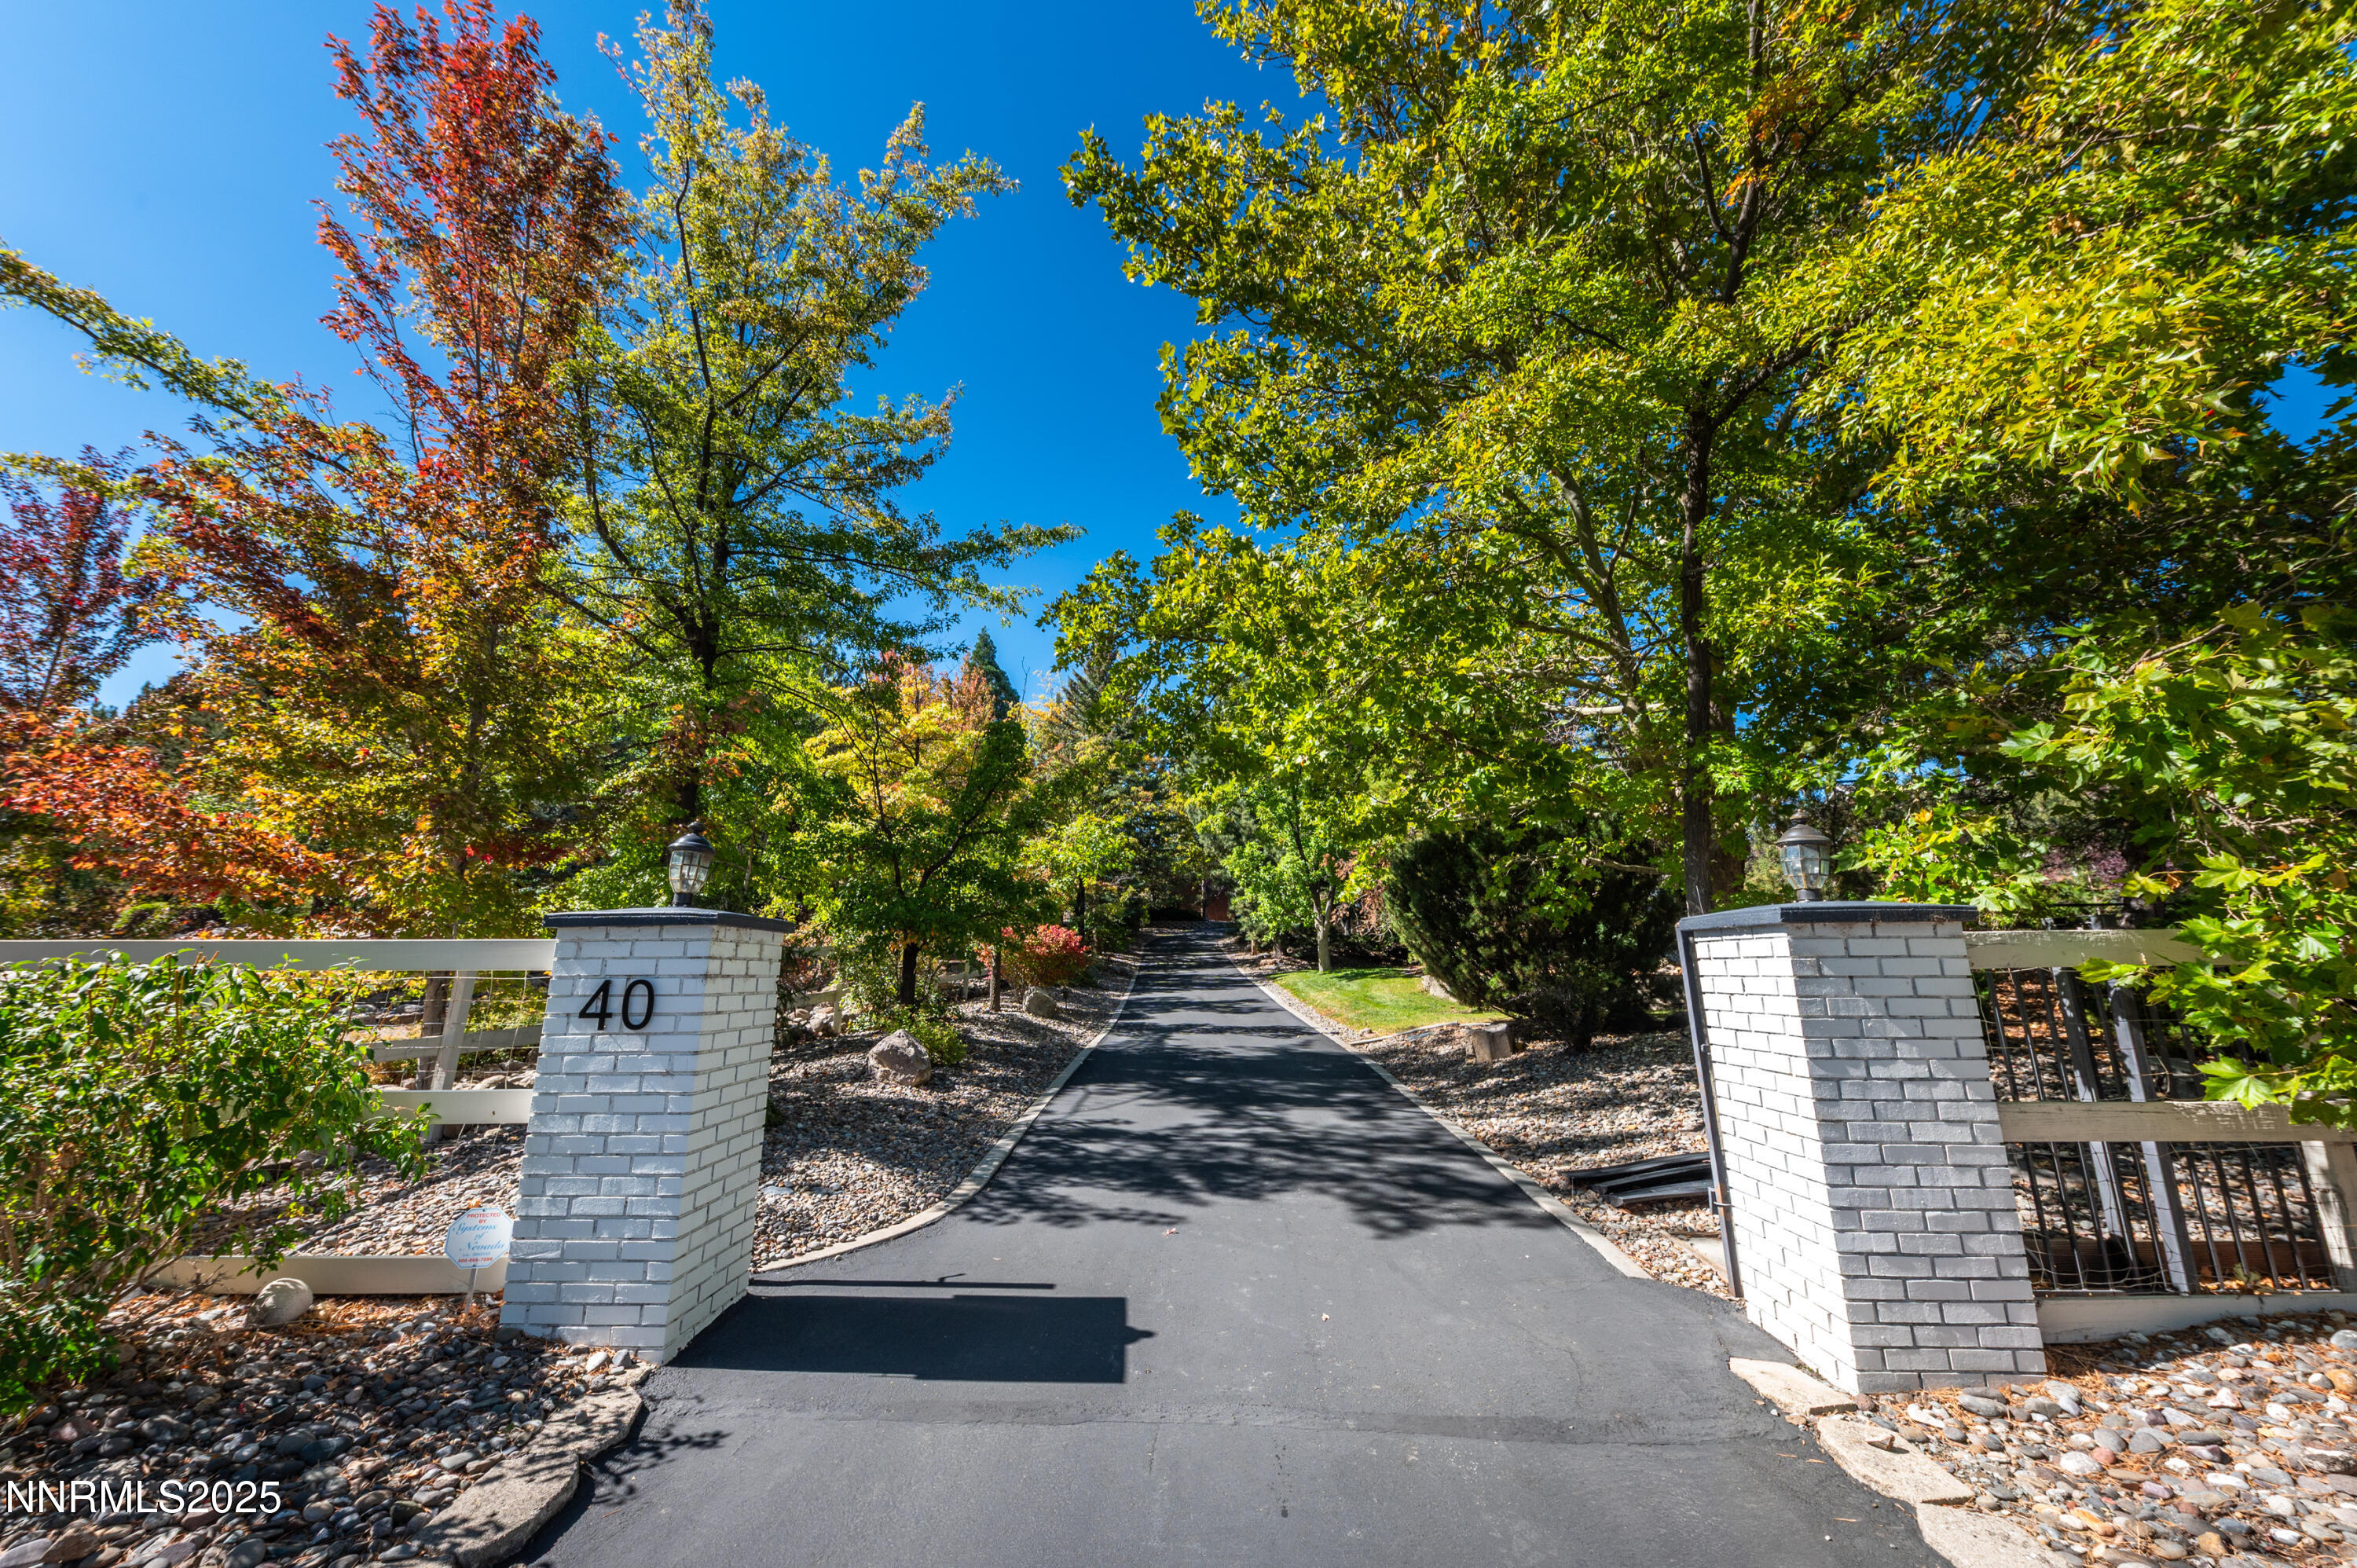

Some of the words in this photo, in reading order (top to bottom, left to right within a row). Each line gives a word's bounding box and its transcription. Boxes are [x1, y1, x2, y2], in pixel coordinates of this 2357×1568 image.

[578, 980, 654, 1031] 40
[453, 1223, 497, 1235] Systems
[474, 1232, 486, 1240] of
[460, 1240, 505, 1251] Nevada
